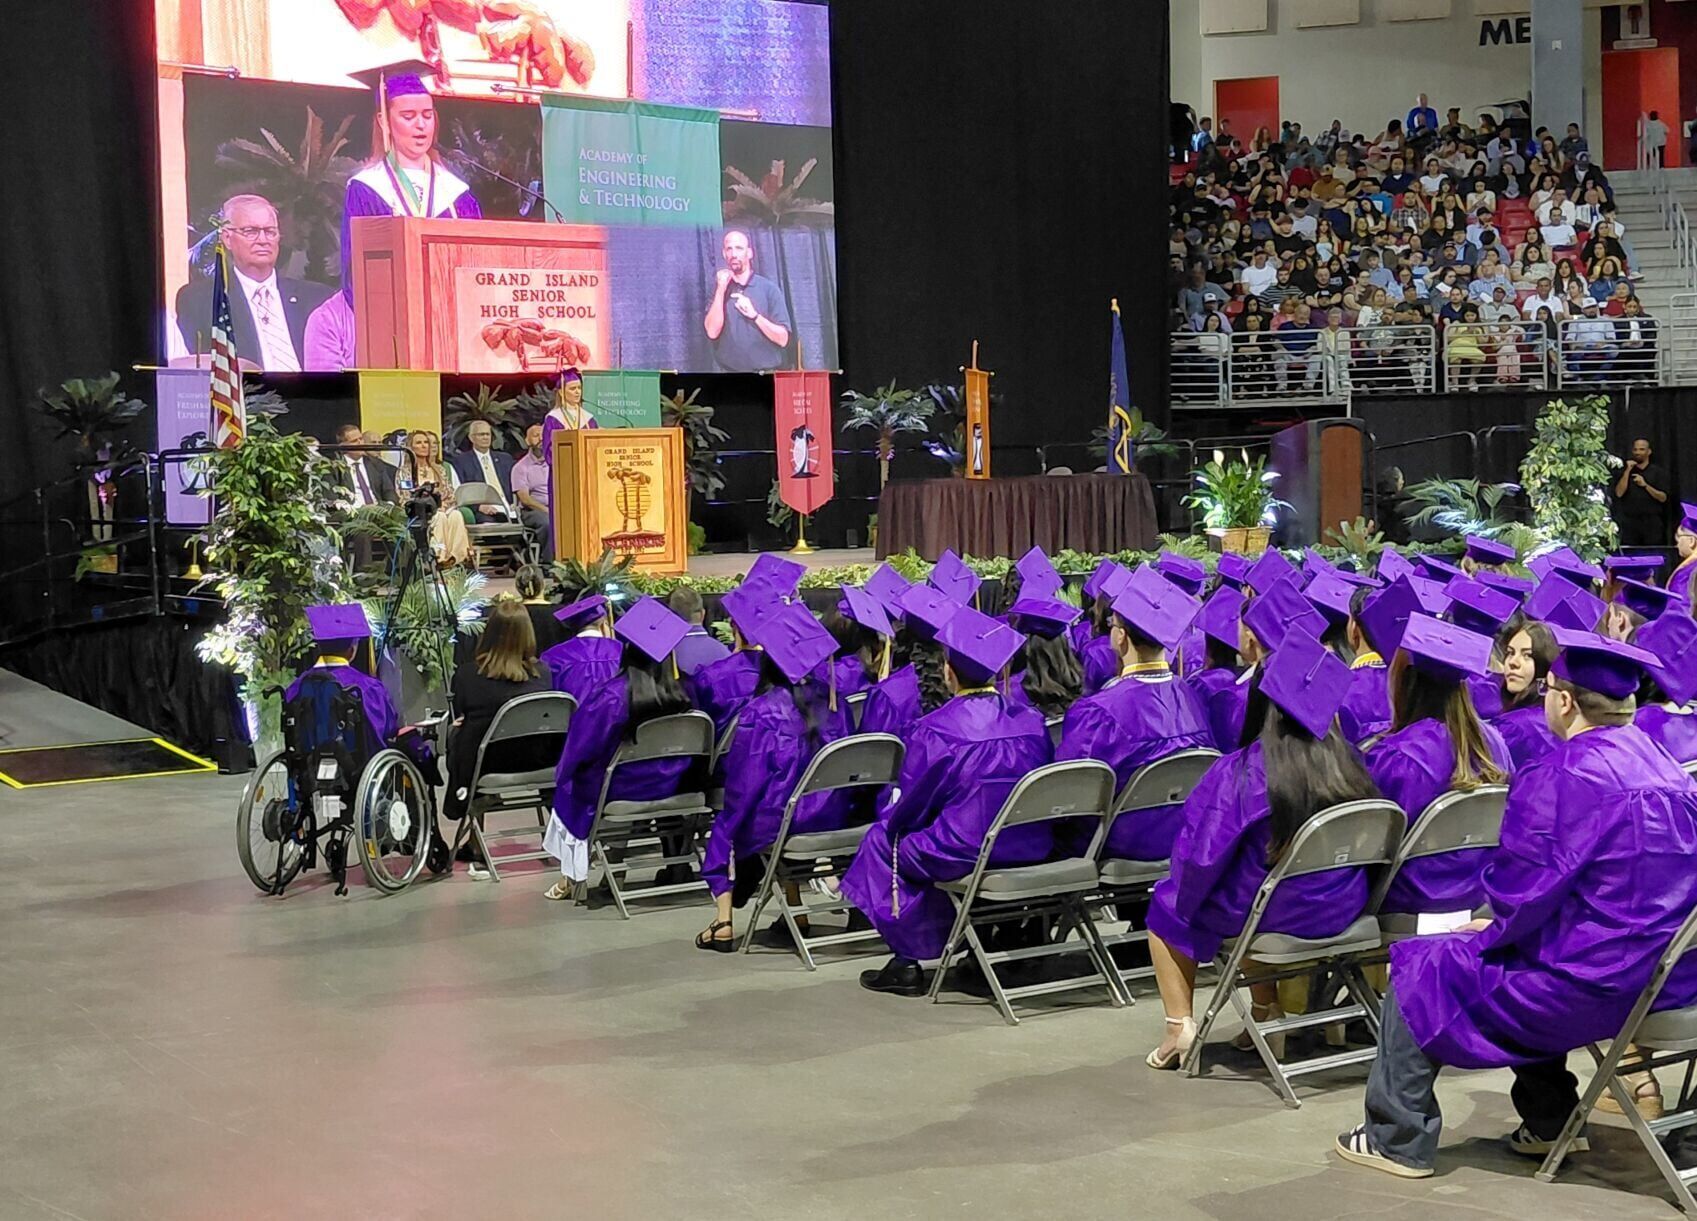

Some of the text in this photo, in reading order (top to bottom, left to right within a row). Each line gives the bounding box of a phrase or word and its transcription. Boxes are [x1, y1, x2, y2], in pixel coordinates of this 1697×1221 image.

[579, 148, 647, 165] ACADEMY OF
[579, 167, 676, 190] ENGINEERING
[579, 188, 690, 212] & TECHNOLOGY
[475, 273, 599, 287] GRAND ISLAND
[512, 289, 566, 302] SENIOR
[480, 305, 596, 318] HIGH SCHOOL
